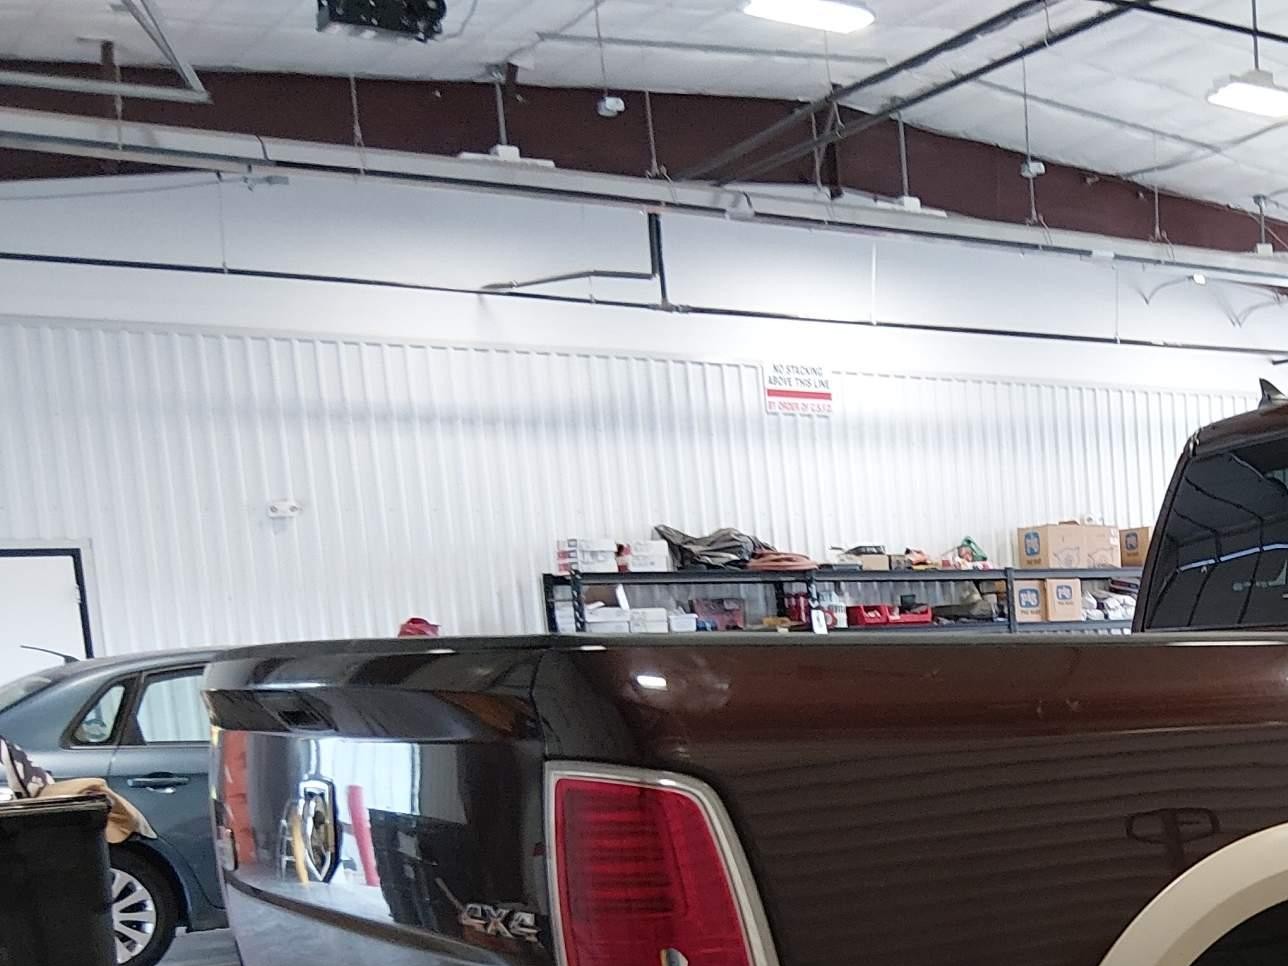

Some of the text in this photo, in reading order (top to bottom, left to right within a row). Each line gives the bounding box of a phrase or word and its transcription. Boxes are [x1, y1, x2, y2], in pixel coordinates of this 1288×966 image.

[773, 363, 823, 377] NO STACKING
[768, 375, 830, 390] ABOVE THIS LINE
[778, 401, 800, 411] ORDER
